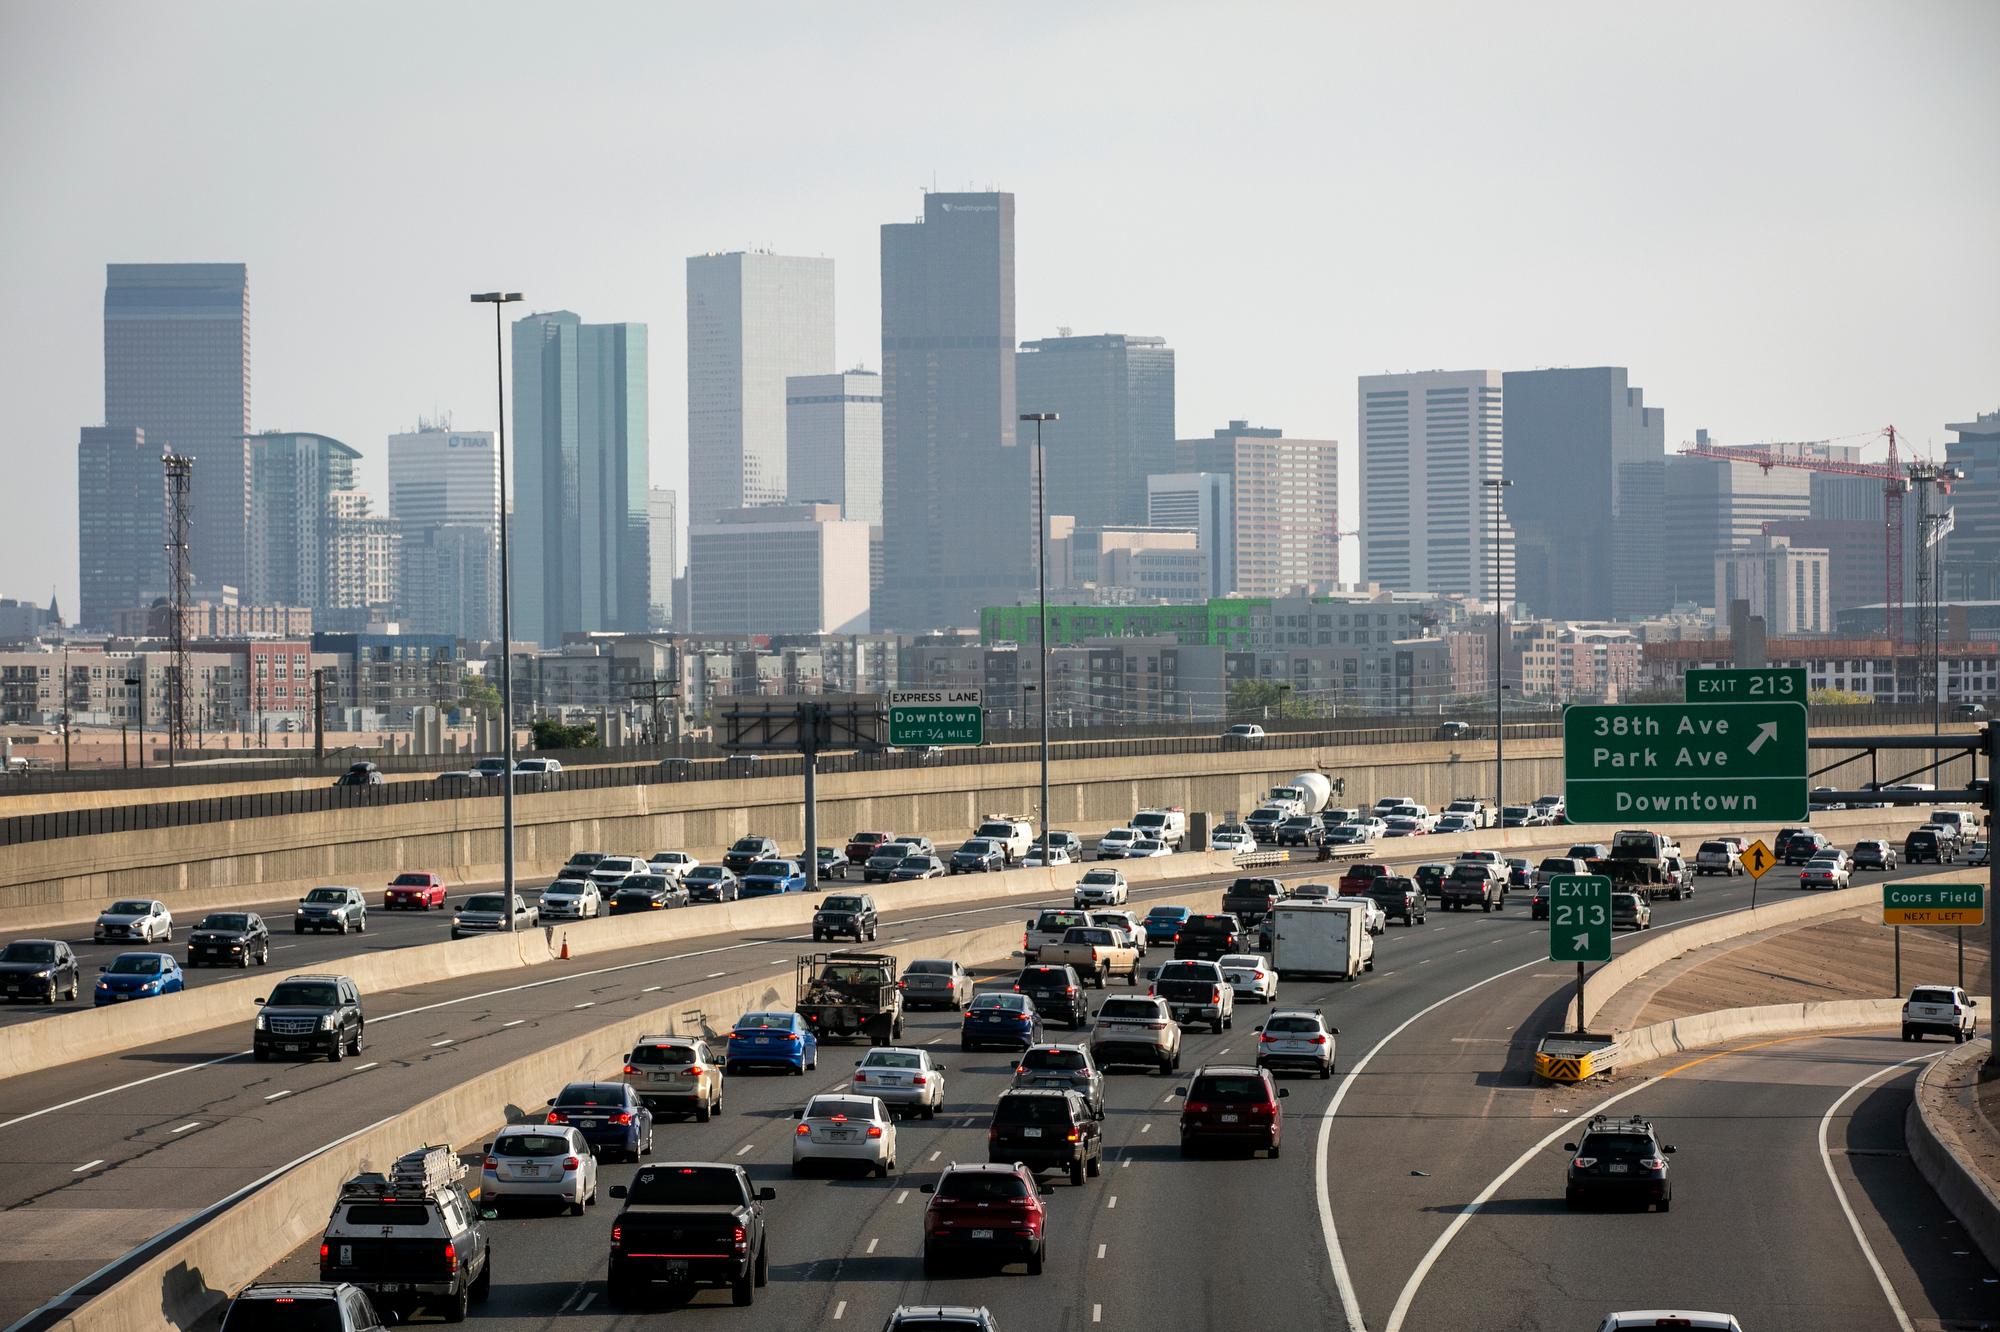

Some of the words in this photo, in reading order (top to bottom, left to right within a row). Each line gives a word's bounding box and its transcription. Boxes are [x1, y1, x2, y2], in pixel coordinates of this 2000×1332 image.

[461, 437, 488, 448] TIAA
[1698, 679, 1737, 693] EXIT
[1749, 676, 1794, 695] 213
[893, 693, 942, 703] EXPRESS
[949, 693, 978, 702] LANE
[896, 712, 976, 723] Downtown
[1594, 716, 1659, 736] 38th
[1676, 715, 1729, 735] Ave
[899, 731, 923, 739] LEFT
[948, 730, 973, 738] MILE
[1593, 747, 1657, 768] Park
[1674, 747, 1728, 767] Ave
[1616, 791, 1757, 812] Downtown
[1559, 882, 1602, 897] EXIT
[1891, 891, 1932, 903] Coors
[1940, 891, 1976, 903] Field
[1556, 904, 1606, 926] 213
[1904, 912, 1932, 922] NEXT
[1937, 911, 1964, 921] LEFT
